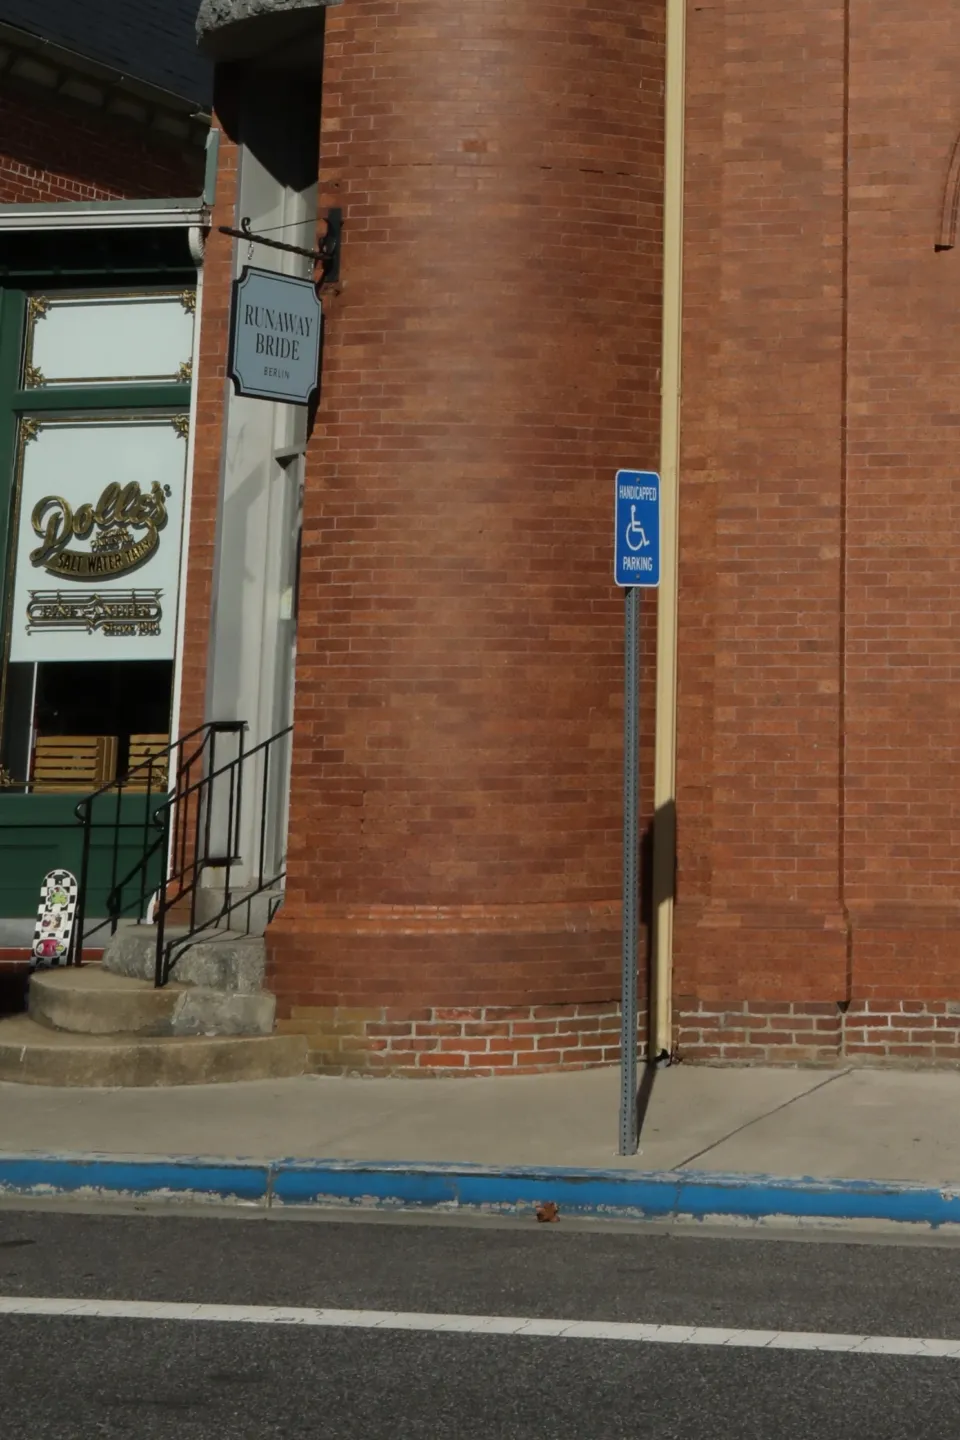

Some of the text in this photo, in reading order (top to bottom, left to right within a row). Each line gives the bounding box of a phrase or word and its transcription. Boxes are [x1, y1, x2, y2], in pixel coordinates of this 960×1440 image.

[245, 304, 312, 337] RUNAWAY
[255, 333, 300, 361] BRIDE
[264, 366, 290, 379] BERLIN
[619, 485, 657, 501] HANDICAPPED
[30, 480, 167, 563] Dolle's
[58, 553, 83, 572] SALT
[88, 554, 122, 573] WATER
[622, 556, 653, 571] PARKING
